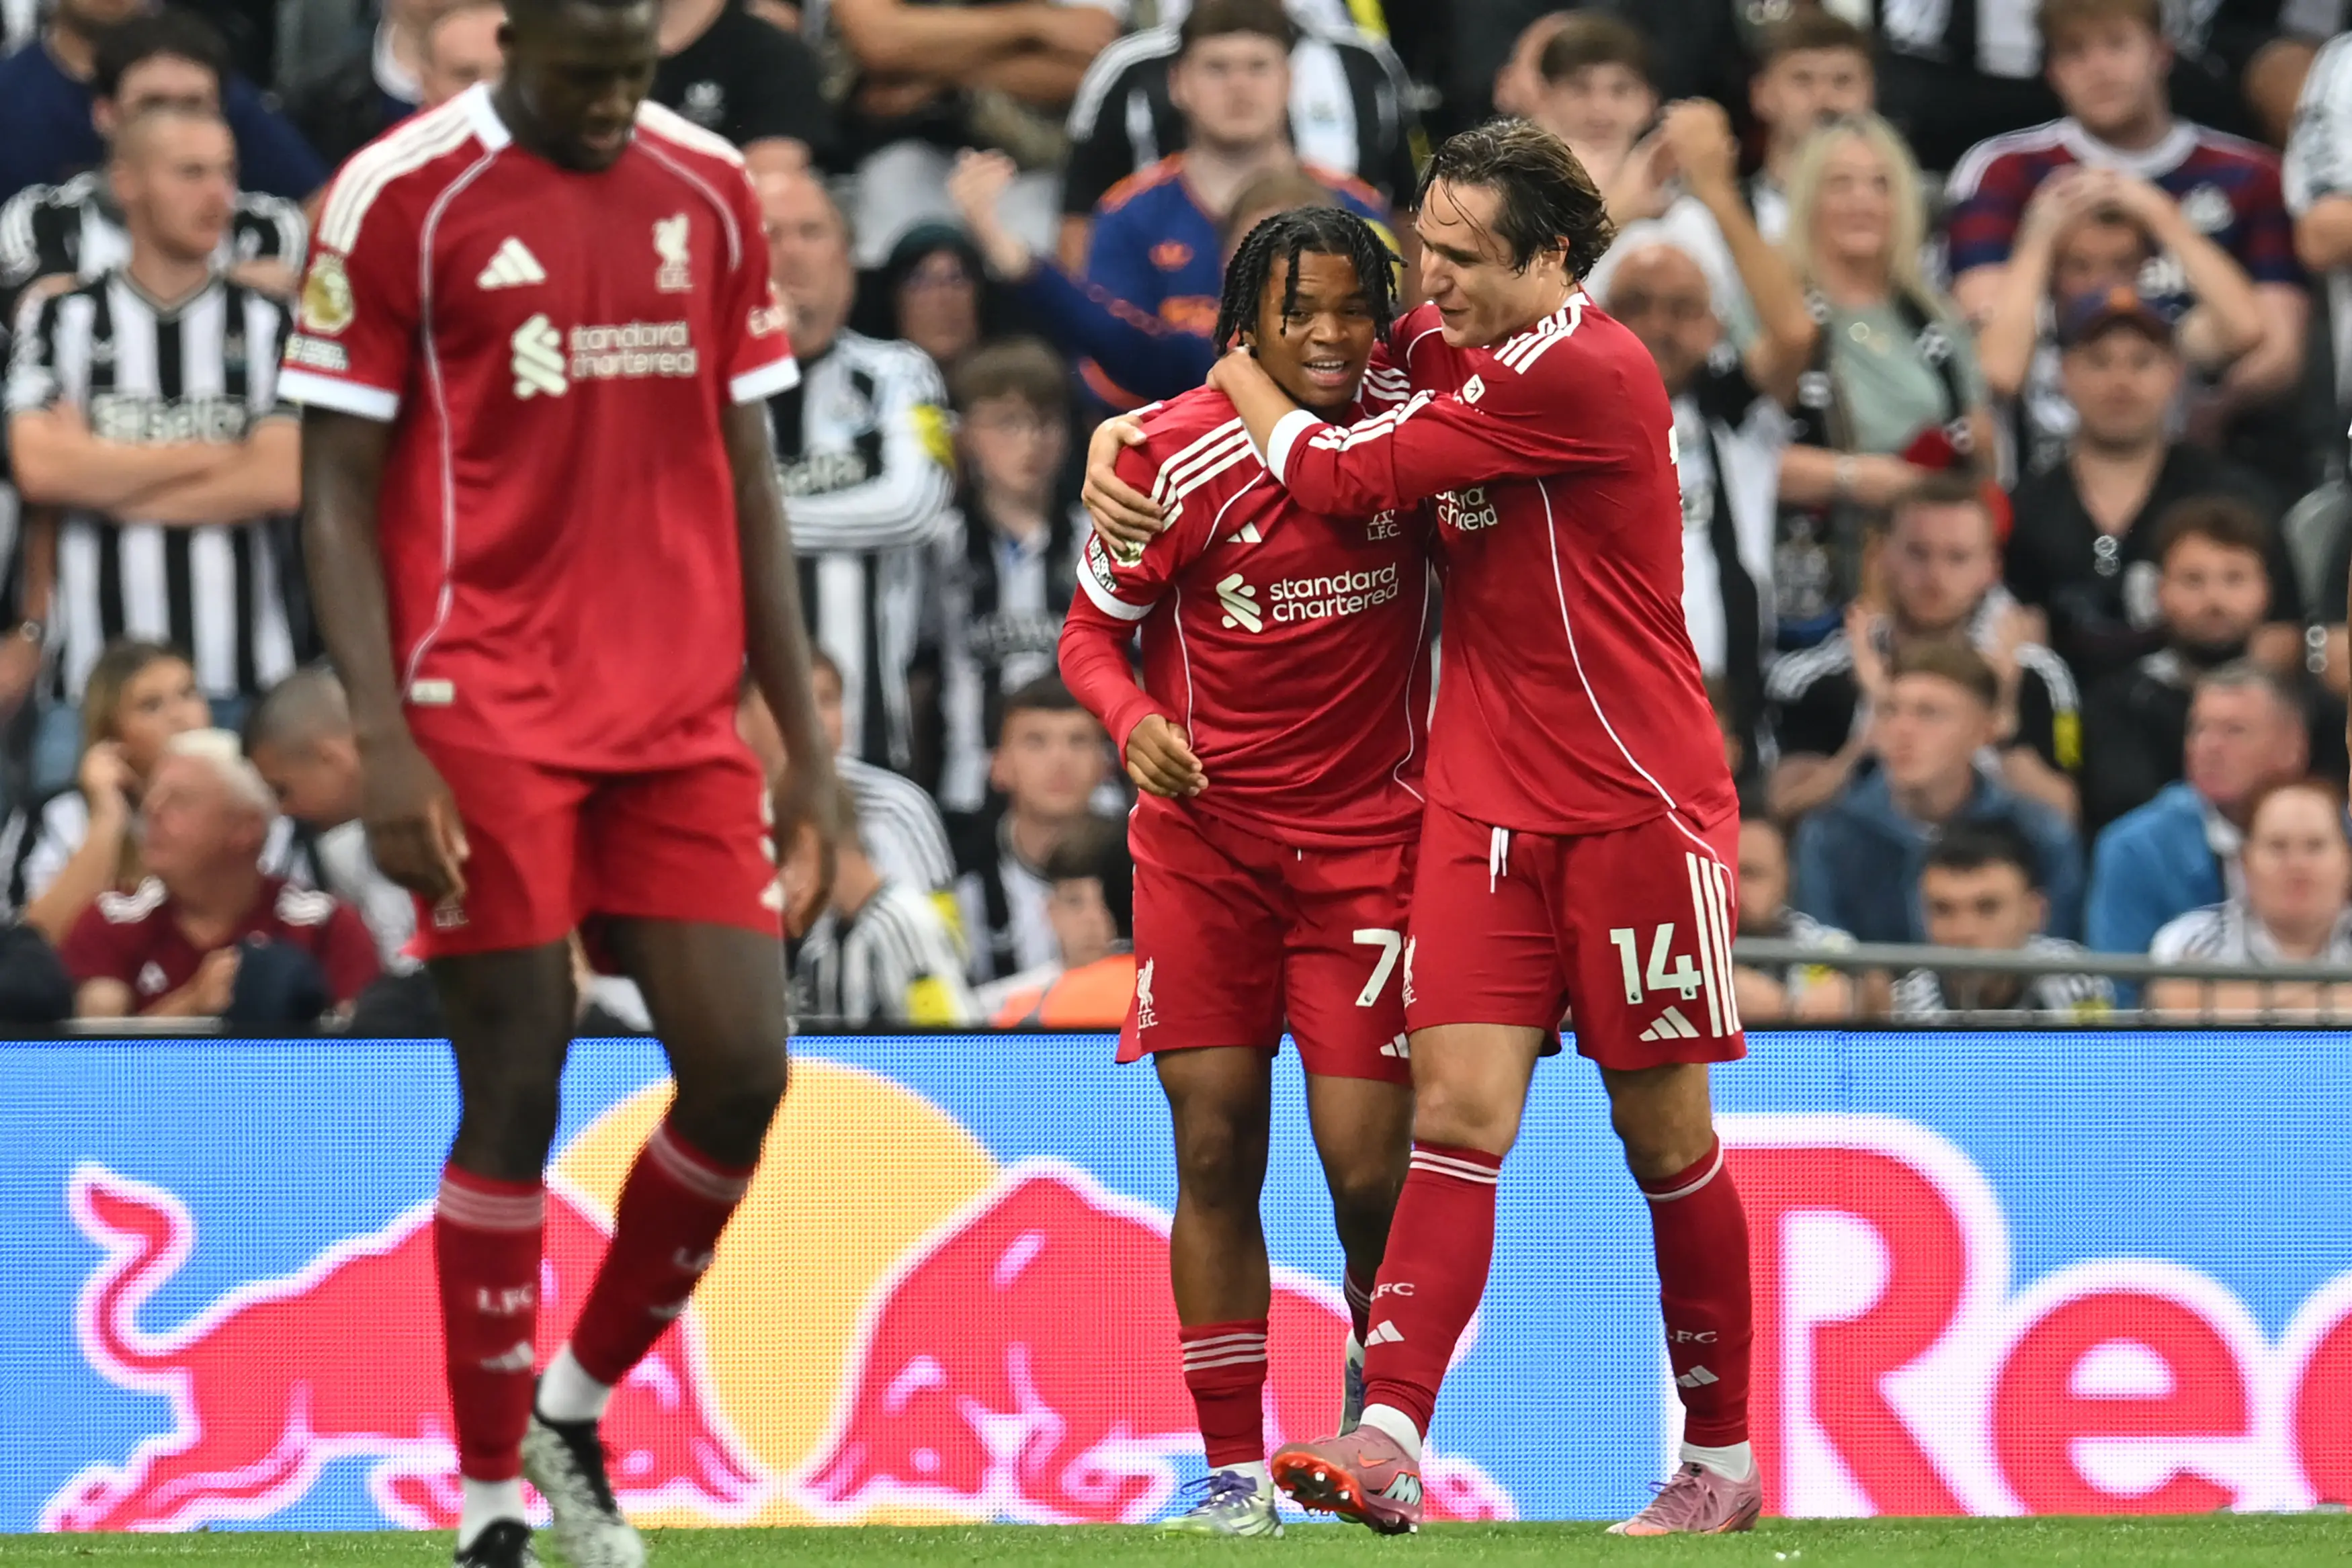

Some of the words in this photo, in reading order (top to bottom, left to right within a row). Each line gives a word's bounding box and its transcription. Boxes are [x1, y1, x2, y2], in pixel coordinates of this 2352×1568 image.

[1269, 562, 1396, 601] standard
[1272, 578, 1399, 622] chartered
[1353, 928, 1401, 1007] 7
[1609, 922, 1702, 1004] 14
[1720, 1143, 2352, 1517] Re
